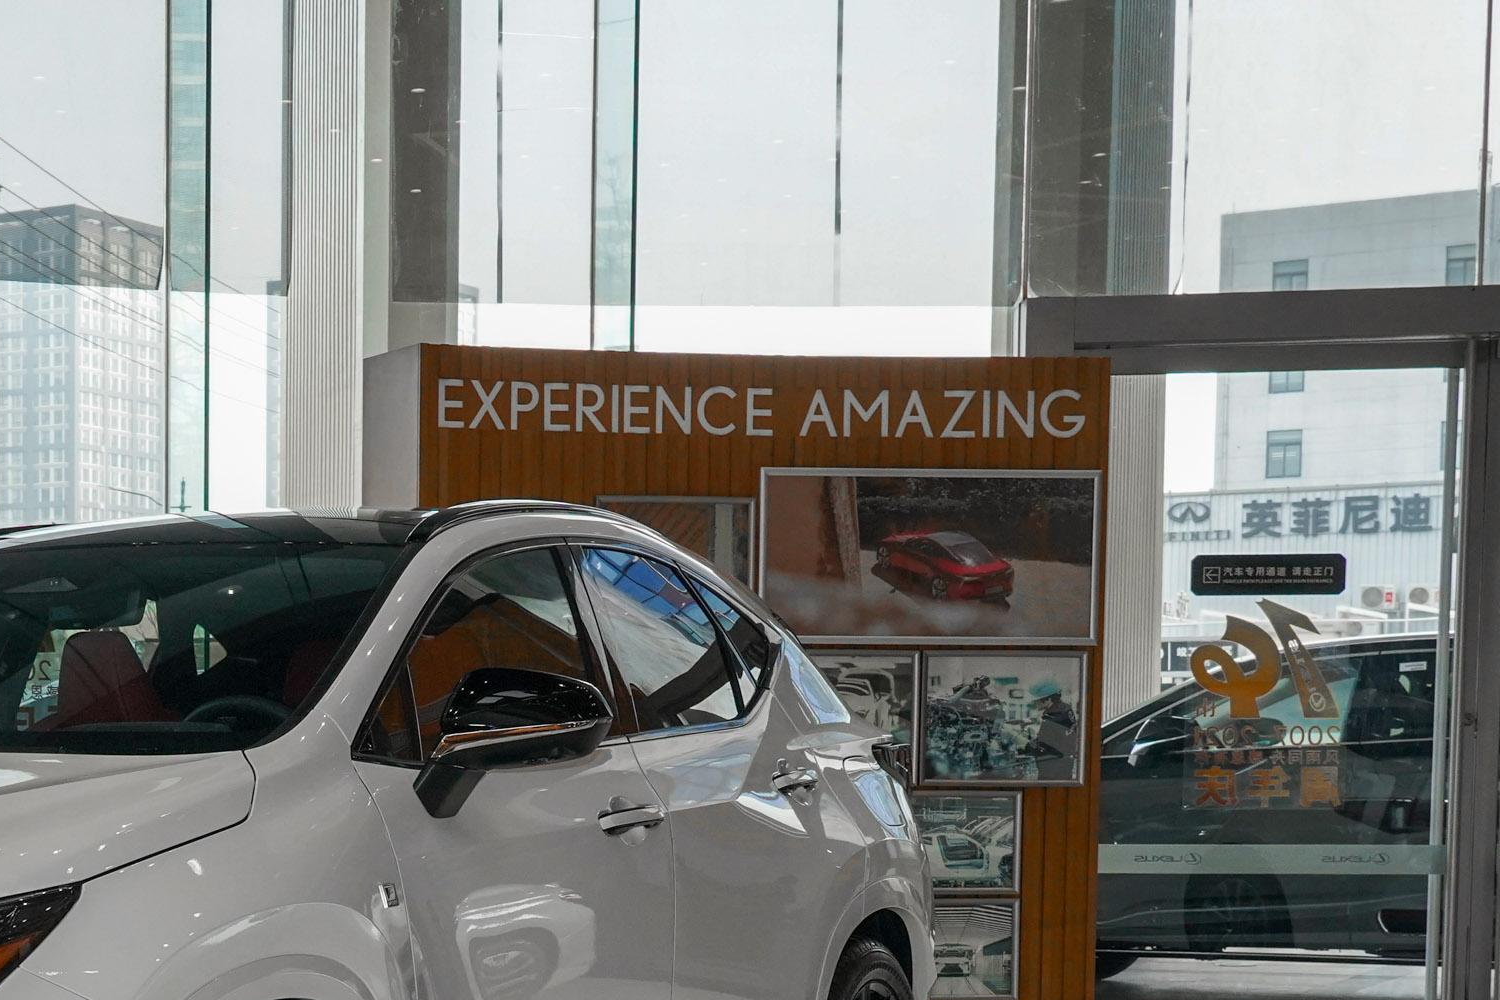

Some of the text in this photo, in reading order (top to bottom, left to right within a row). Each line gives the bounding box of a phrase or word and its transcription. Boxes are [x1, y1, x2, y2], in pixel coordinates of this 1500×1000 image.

[437, 378, 1086, 439] EXPERIENCE AMAZING
[1241, 493, 1433, 538] 英菲尼迪
[1292, 566, 1334, 577] 请走正门
